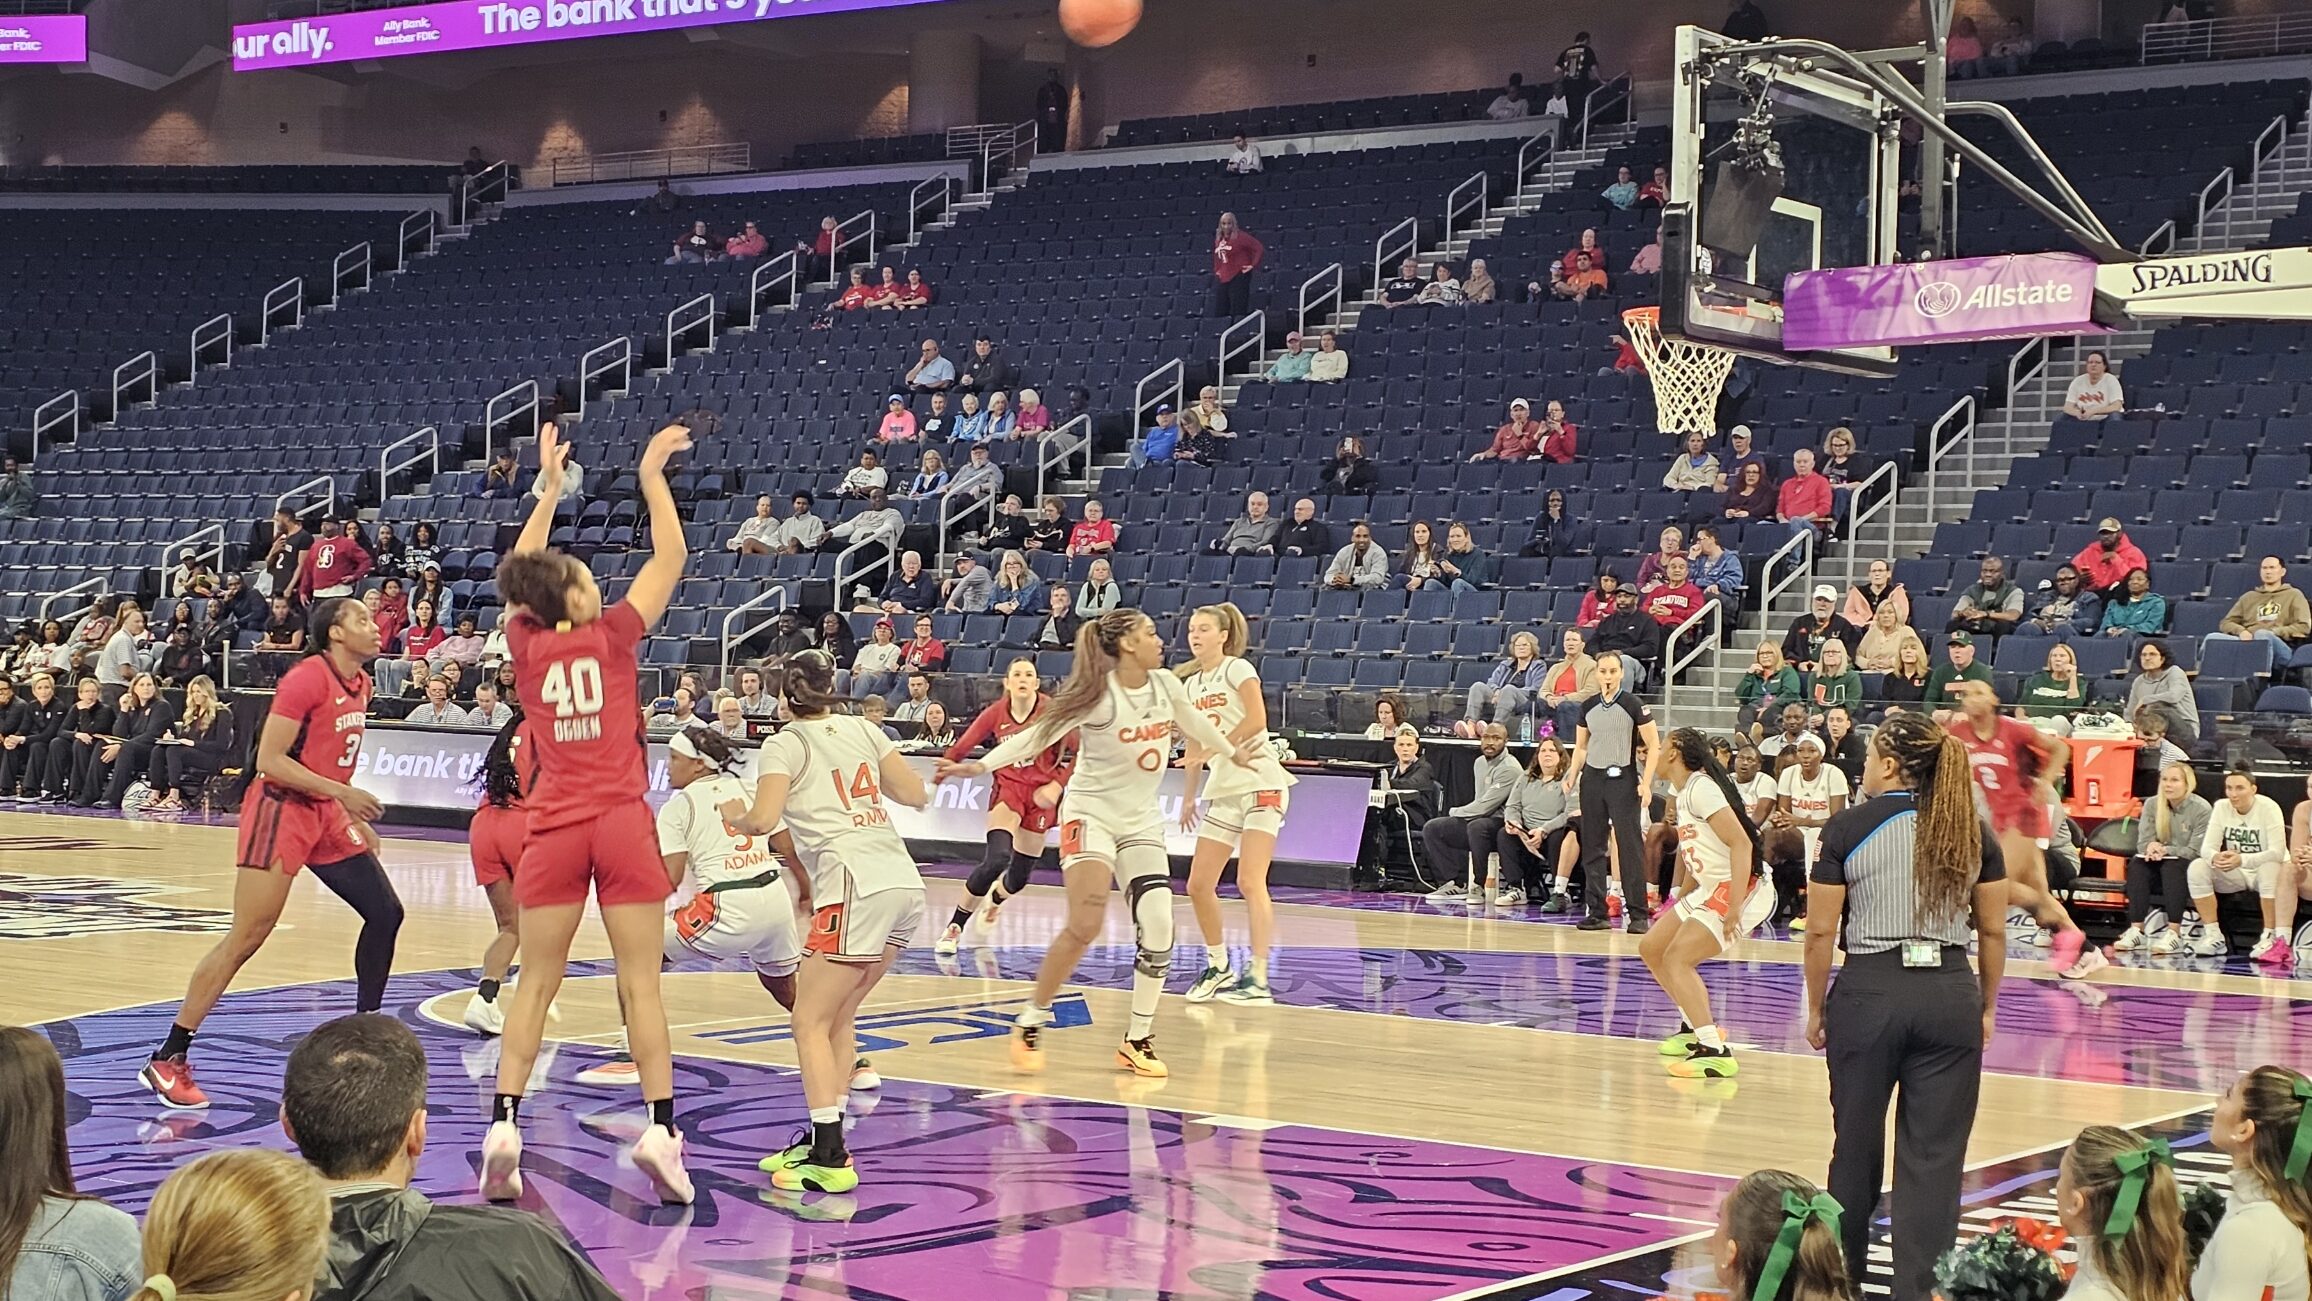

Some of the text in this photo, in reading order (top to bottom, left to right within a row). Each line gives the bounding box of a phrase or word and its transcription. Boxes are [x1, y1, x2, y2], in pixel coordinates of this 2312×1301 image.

[383, 20, 402, 33] Ally
[478, 3, 542, 34] The
[547, 0, 637, 28] bank
[13, 41, 42, 51] FDIC
[272, 22, 334, 58] ally.
[374, 30, 440, 46] Member FDIC
[2132, 252, 2273, 294] SPALDING
[1962, 280, 2073, 310] Allstate
[275, 553, 284, 569] 2
[541, 656, 604, 718] 40
[1814, 683, 1846, 707] U
[335, 711, 366, 733] STANF
[553, 714, 602, 742] OGDEN
[337, 733, 361, 767] 3
[373, 747, 456, 779] bank
[1137, 747, 1162, 772] 0
[831, 761, 880, 811] 14
[1978, 766, 2002, 790] 2
[933, 778, 985, 811] nk
[1791, 798, 1829, 810] CANES
[2223, 826, 2261, 843] LEGACY
